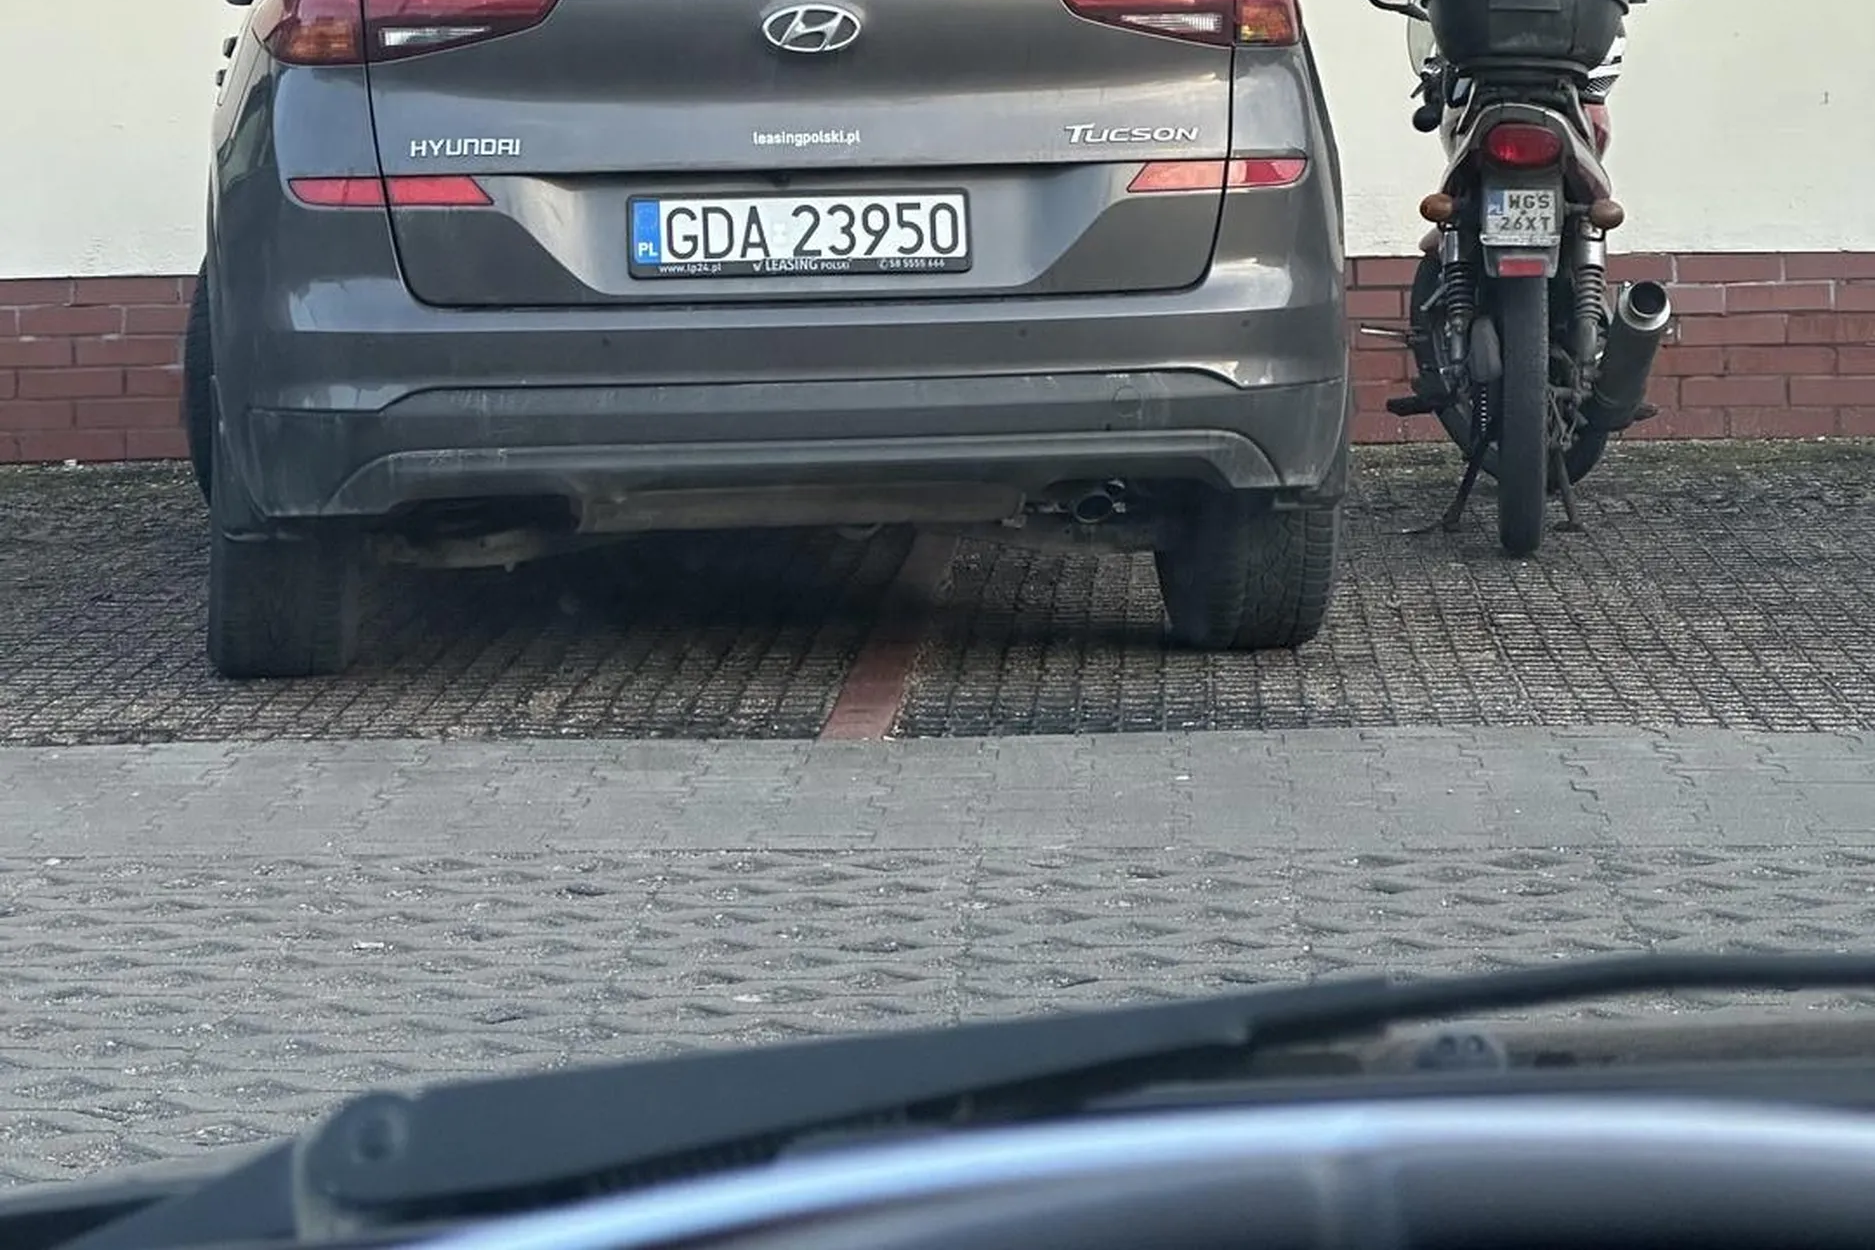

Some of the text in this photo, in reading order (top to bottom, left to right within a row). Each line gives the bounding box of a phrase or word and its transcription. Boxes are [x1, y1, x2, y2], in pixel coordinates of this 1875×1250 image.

[753, 130, 861, 147] leasingpolski.pl
[1065, 123, 1198, 143] TUCSON
[410, 138, 520, 157] HYUNDAI
[1508, 194, 1550, 209] WGS
[666, 203, 959, 259] GDA 23950
[638, 242, 658, 257] PL
[764, 257, 850, 272] LEASING POLSKI
